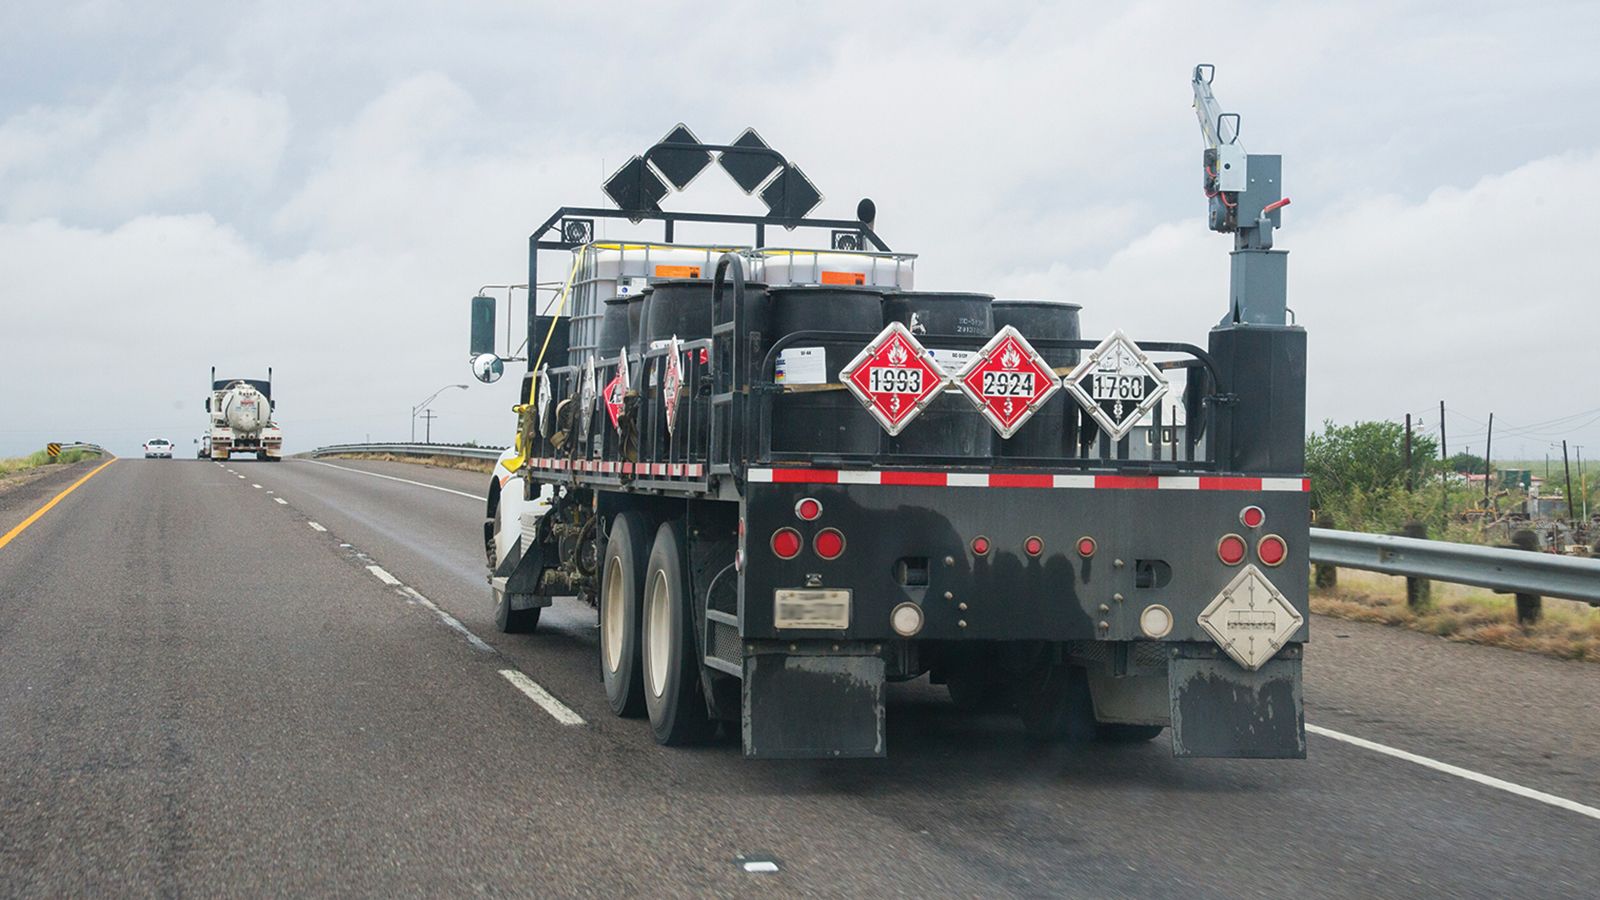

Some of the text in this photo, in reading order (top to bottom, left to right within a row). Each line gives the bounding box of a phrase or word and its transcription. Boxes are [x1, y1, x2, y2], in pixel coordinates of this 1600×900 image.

[871, 369, 920, 393] 1993
[984, 372, 1033, 396] 2924
[1095, 375, 1143, 399] 1760
[889, 397, 901, 411] 3
[1003, 400, 1013, 414] 3
[1113, 402, 1123, 416] 8
